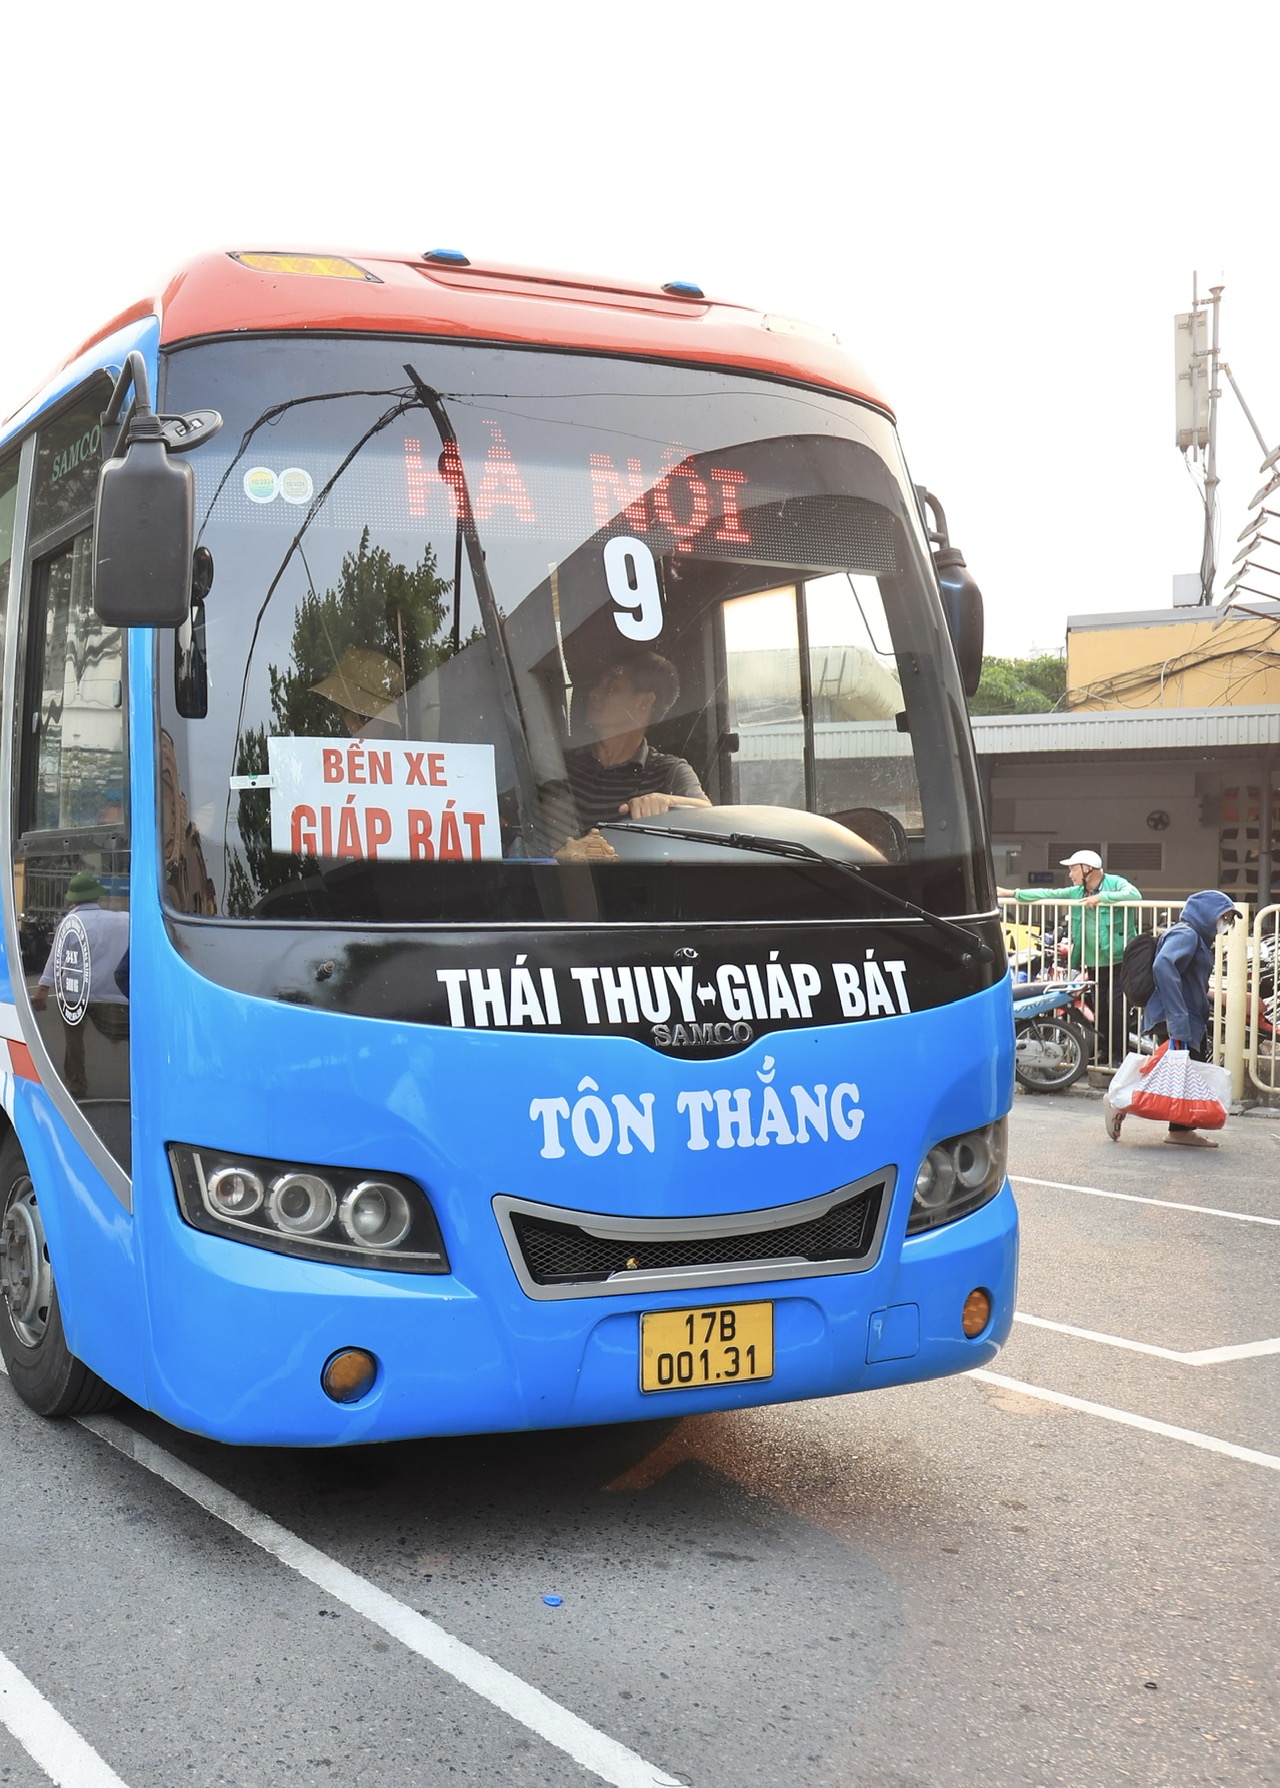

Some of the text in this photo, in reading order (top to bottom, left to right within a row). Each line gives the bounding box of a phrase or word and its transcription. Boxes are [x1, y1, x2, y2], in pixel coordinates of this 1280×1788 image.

[52, 424, 100, 481] SAMCO
[404, 420, 751, 552] HÀ NỘI
[603, 536, 664, 641] 9
[322, 739, 448, 787] BẾN XE
[291, 794, 486, 862] GIÁP BÁT
[436, 954, 562, 1027] THÁI
[716, 950, 822, 1021] GIÁP
[831, 948, 912, 1017] BÁT
[650, 1021, 754, 1047] SAMCO
[529, 1054, 865, 1159] TÔN THẮNG
[686, 1310, 736, 1345] 17B
[657, 1344, 756, 1385] 001.31
